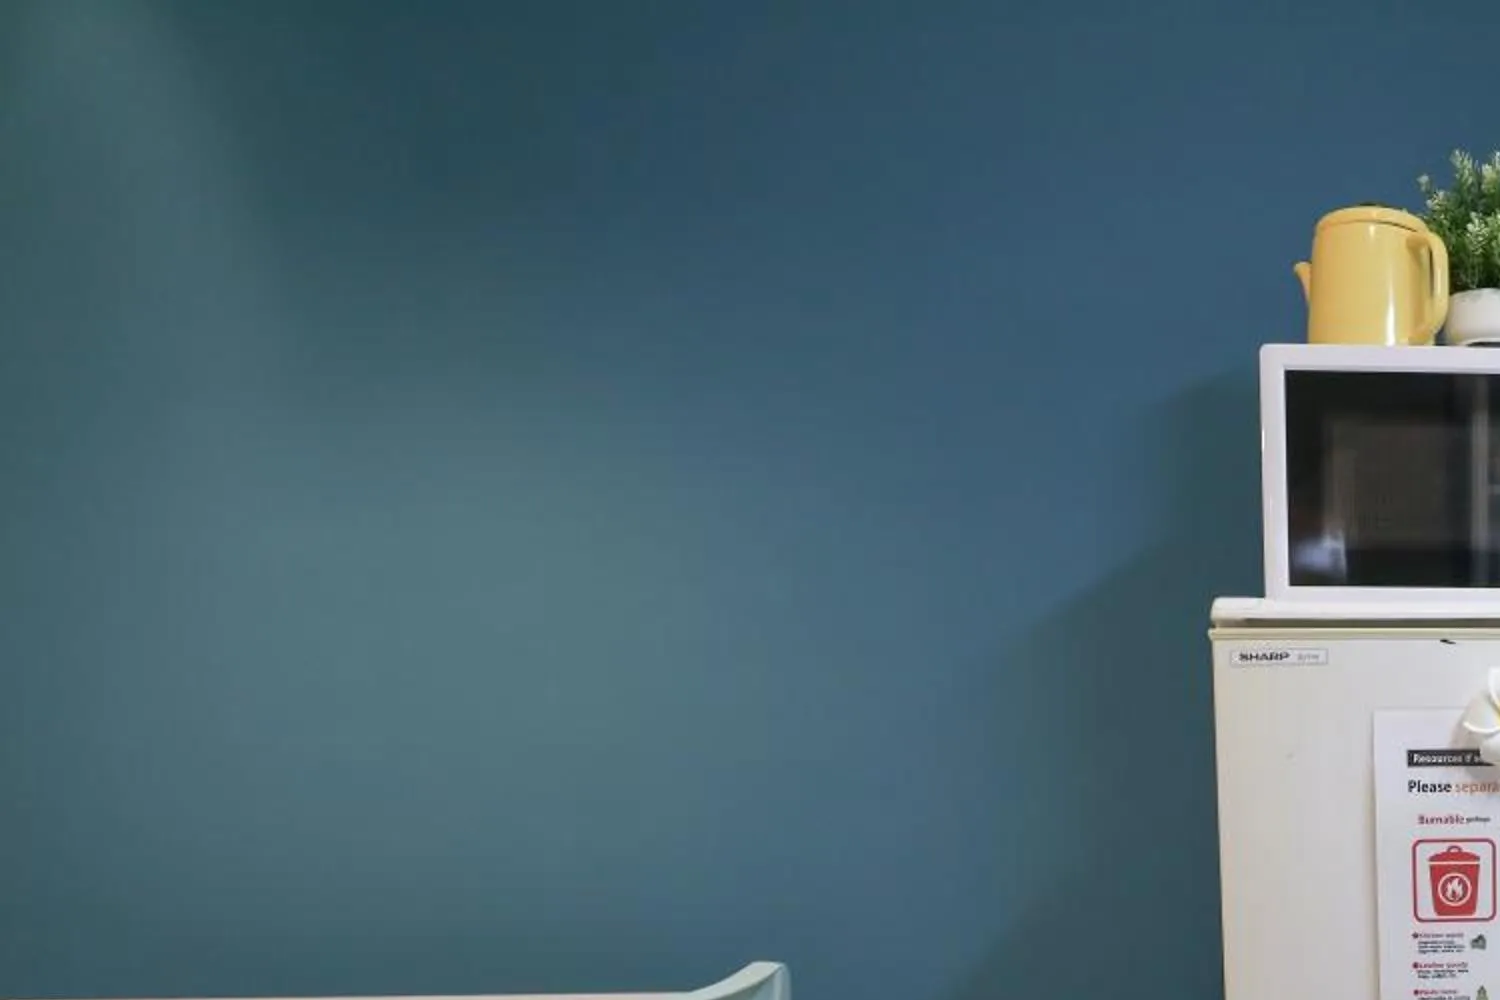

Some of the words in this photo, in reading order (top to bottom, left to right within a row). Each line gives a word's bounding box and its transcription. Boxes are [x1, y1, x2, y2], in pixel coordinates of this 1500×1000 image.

[1238, 651, 1291, 662] SHARP
[1407, 779, 1452, 793] Please
[1417, 813, 1464, 825] Burnable
